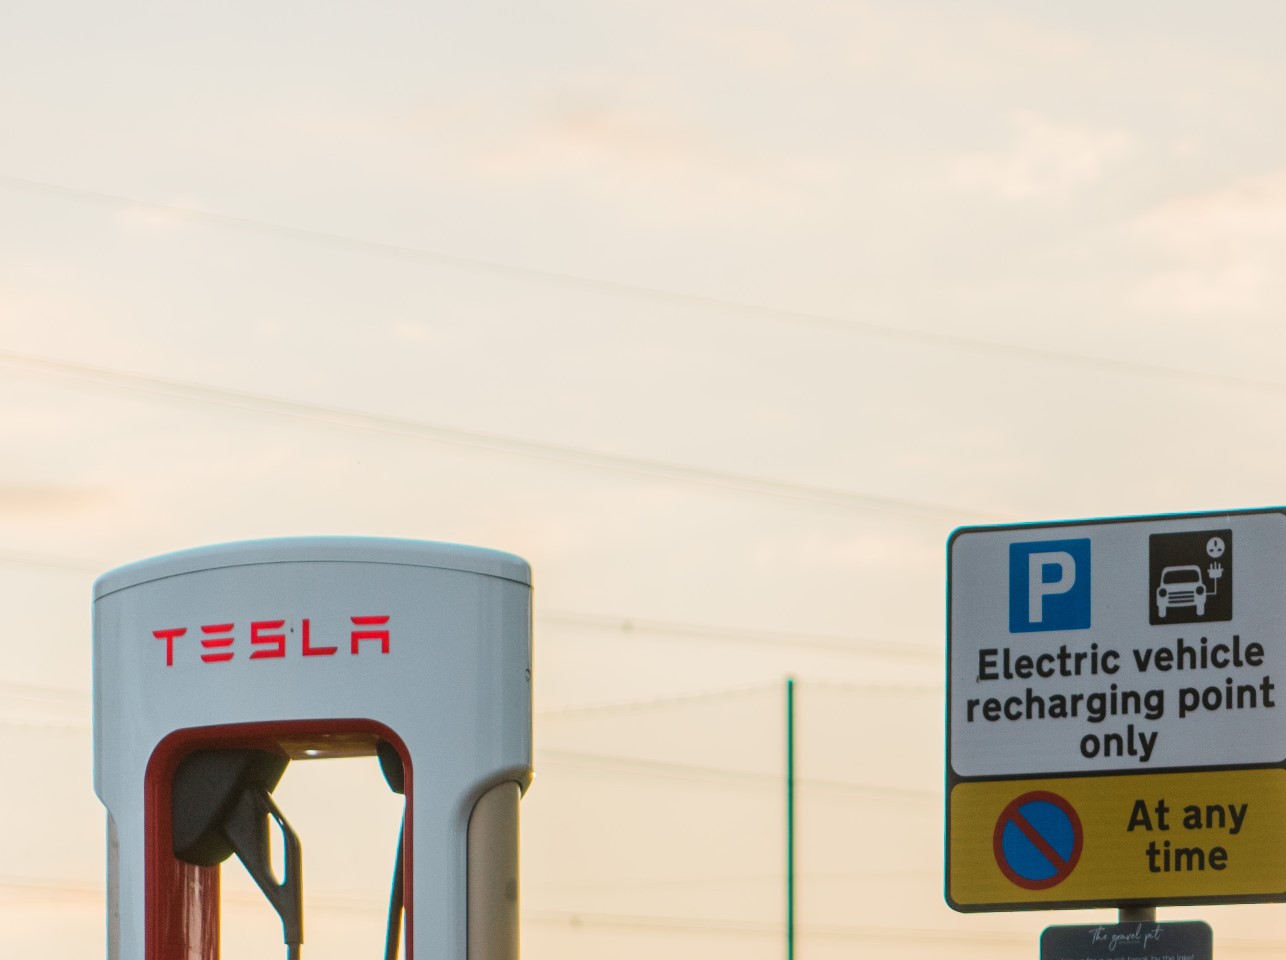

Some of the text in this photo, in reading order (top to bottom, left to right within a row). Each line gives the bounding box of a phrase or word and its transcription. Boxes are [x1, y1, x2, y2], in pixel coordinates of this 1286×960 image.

[1029, 551, 1076, 623] P
[152, 615, 390, 666] TESLA
[978, 636, 1264, 680] Electric vehicle
[967, 676, 1275, 722] recharging point
[1080, 725, 1158, 762] only
[1127, 799, 1248, 834] At any
[1146, 841, 1228, 873] time
[1089, 923, 1163, 951] The gravel pit
